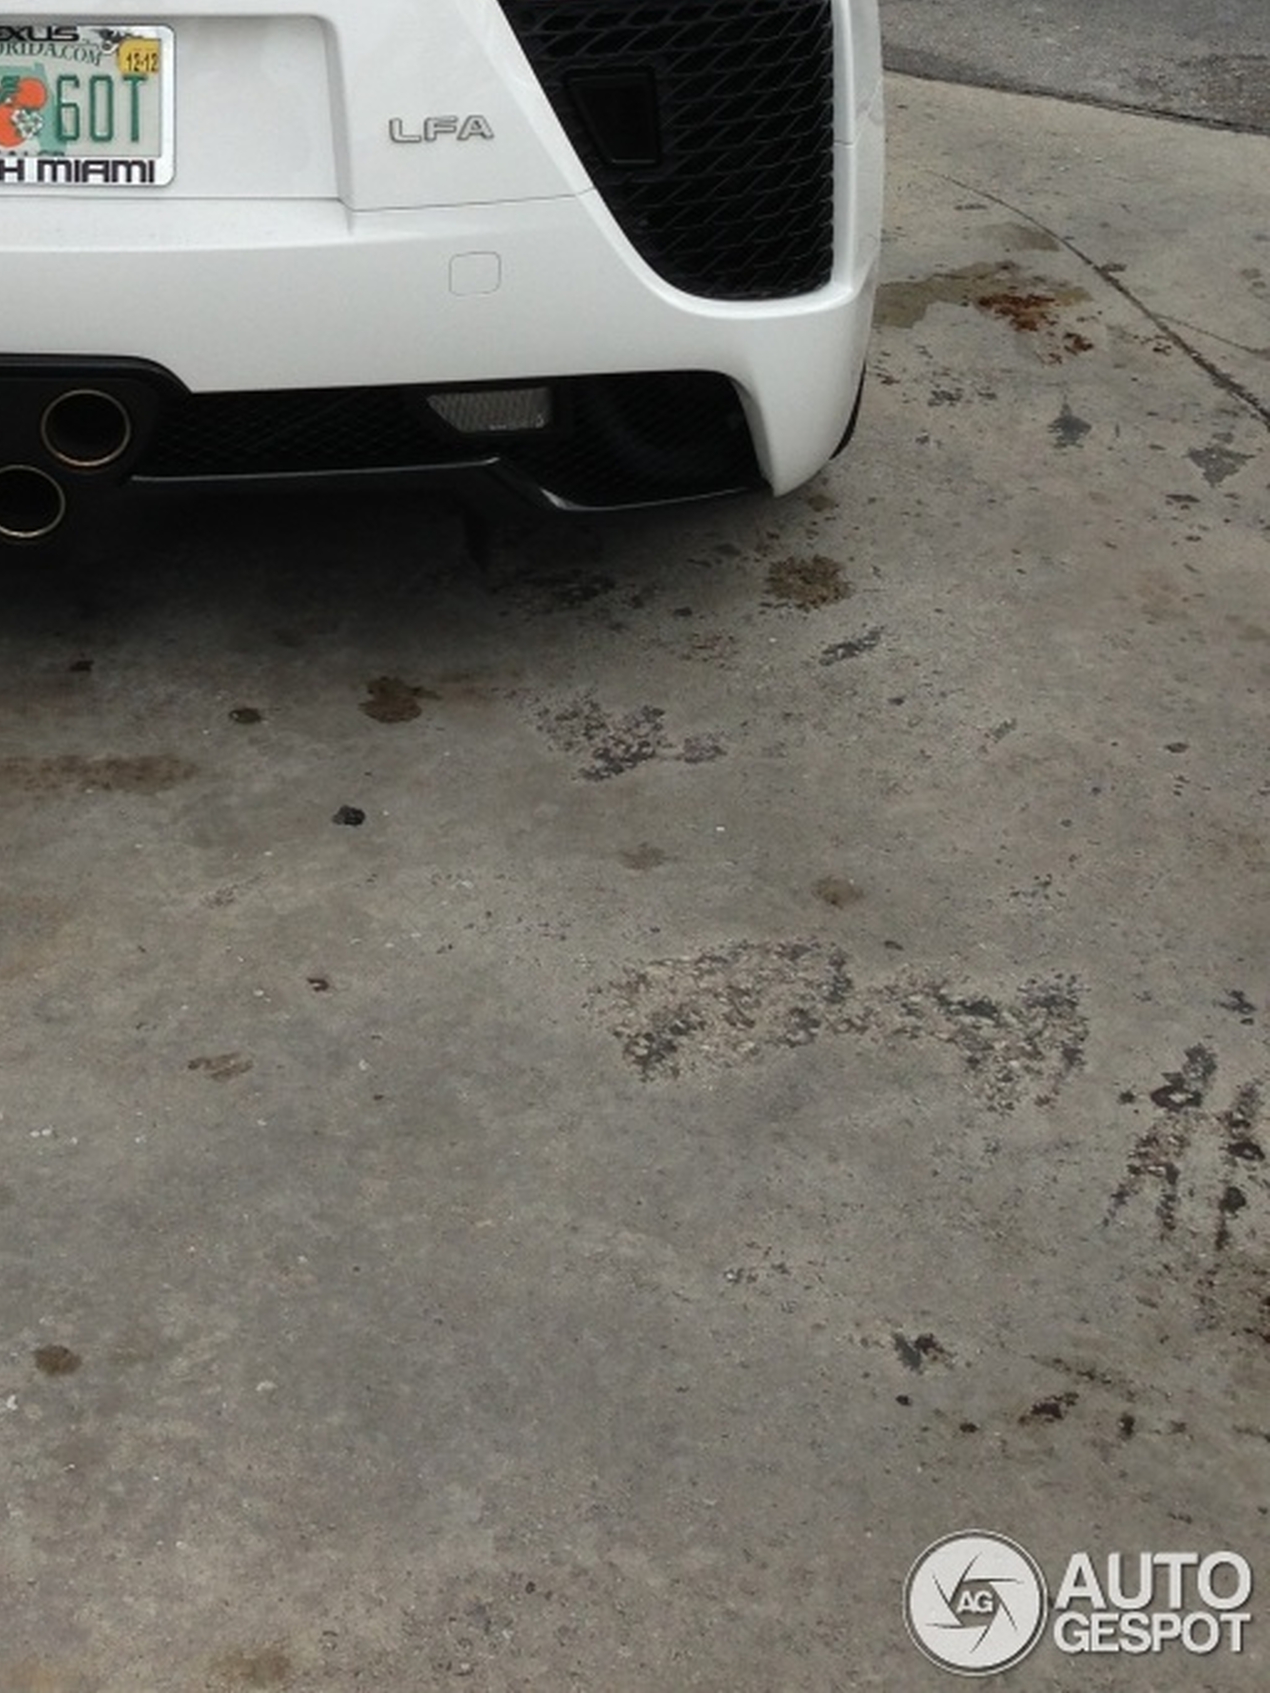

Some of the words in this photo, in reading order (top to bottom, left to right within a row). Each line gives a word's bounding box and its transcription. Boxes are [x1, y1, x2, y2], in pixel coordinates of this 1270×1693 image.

[126, 51, 159, 73] 12-12
[388, 114, 495, 144] LFA
[36, 159, 156, 184] MIAMI
